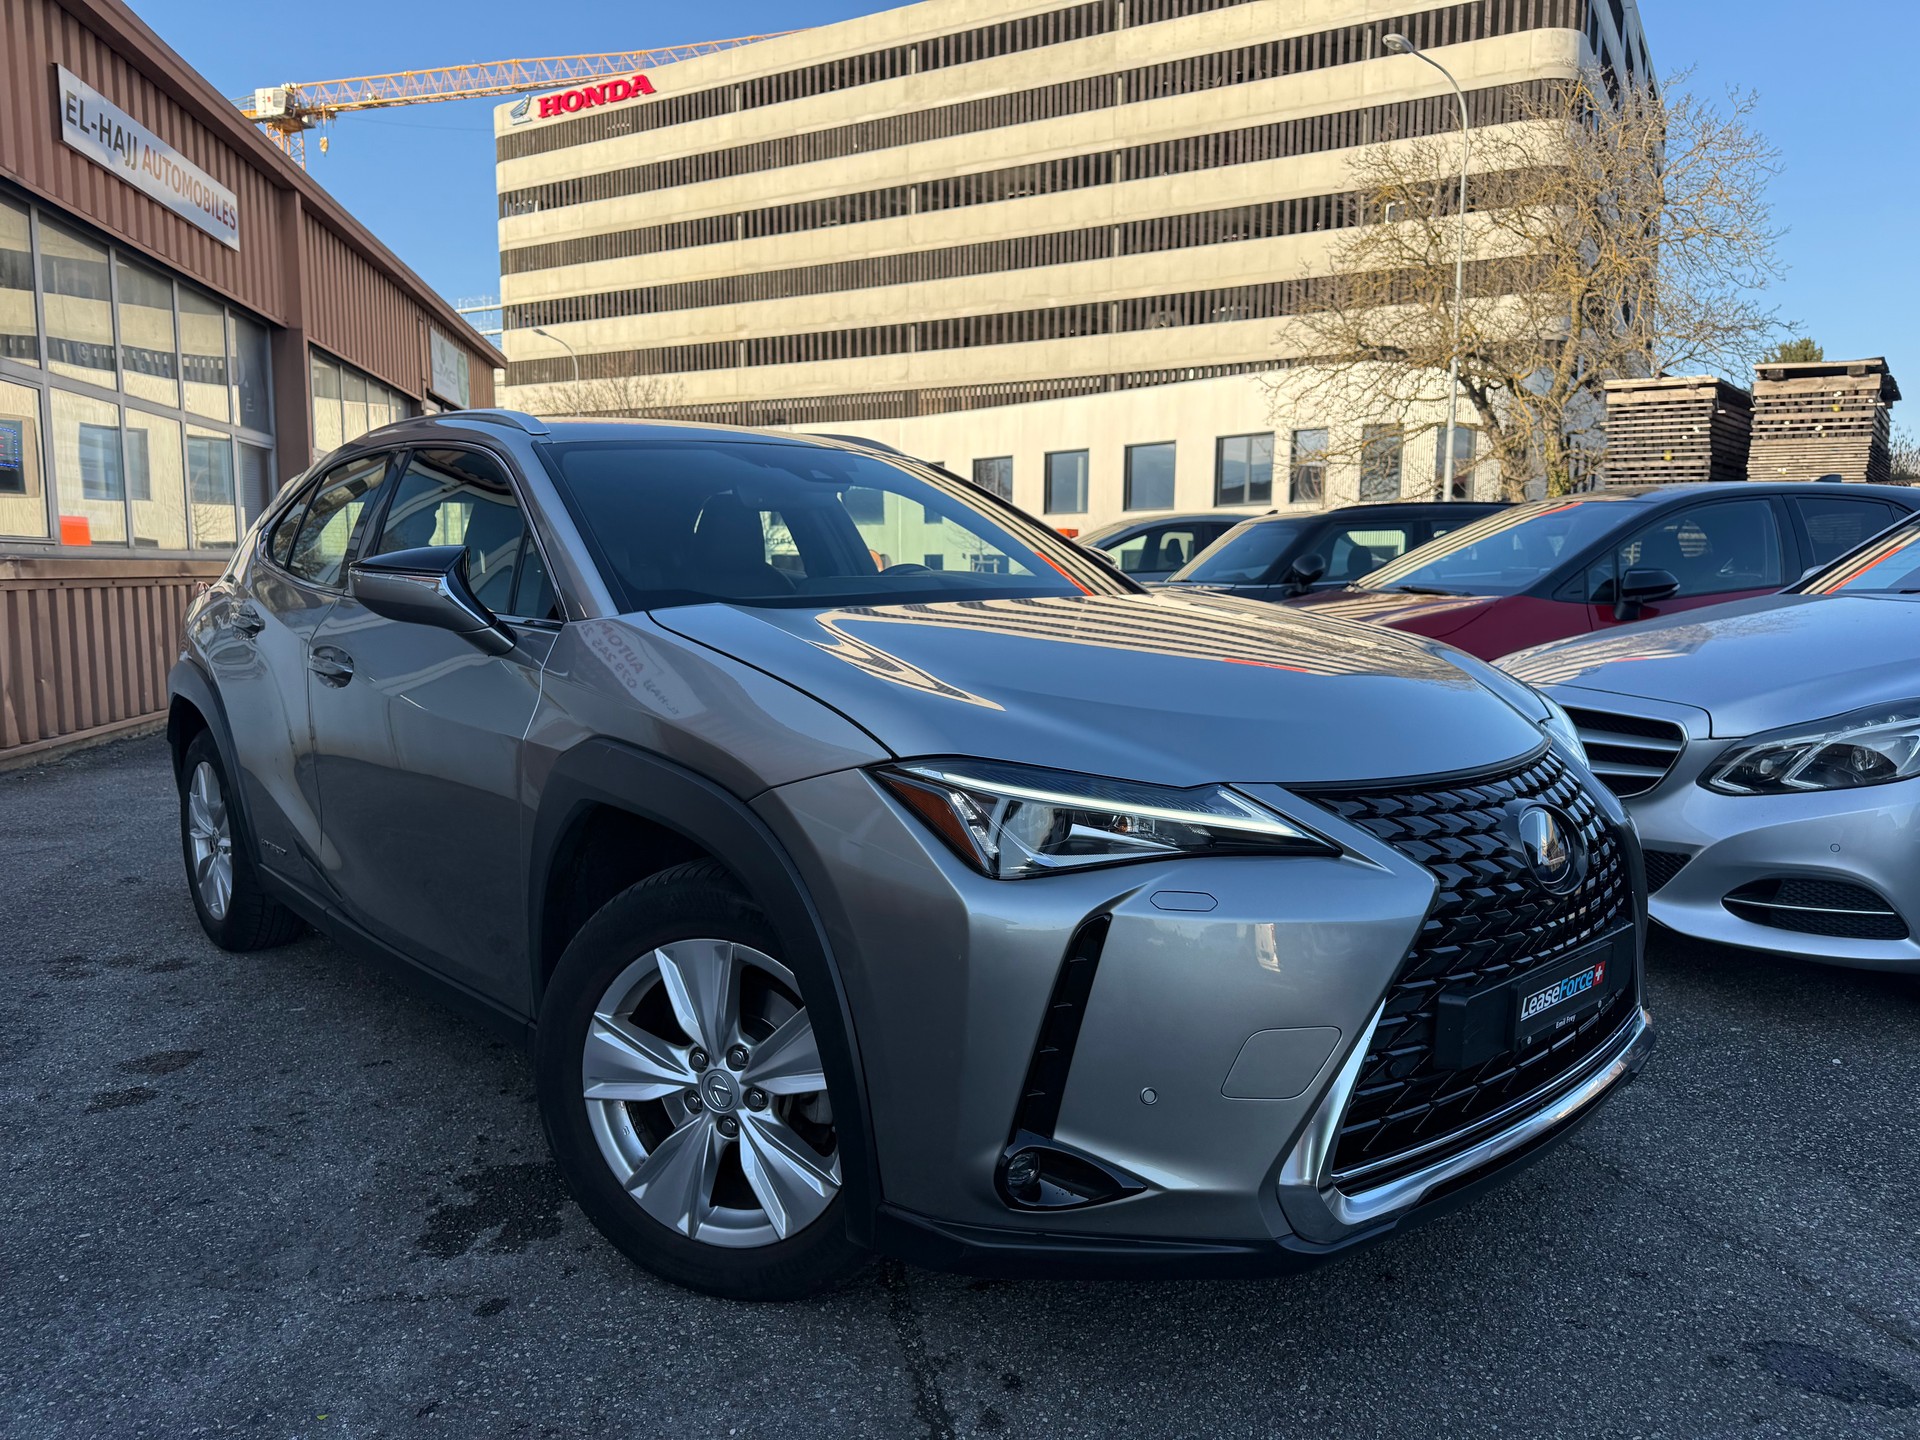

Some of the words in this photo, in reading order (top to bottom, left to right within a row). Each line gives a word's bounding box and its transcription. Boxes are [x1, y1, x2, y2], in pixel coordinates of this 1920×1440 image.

[538, 74, 656, 118] HONDA
[66, 90, 137, 171] EL-HAJJ
[142, 144, 236, 231] AUTOMOBILES
[1521, 970, 1594, 1019] LeaseForce
